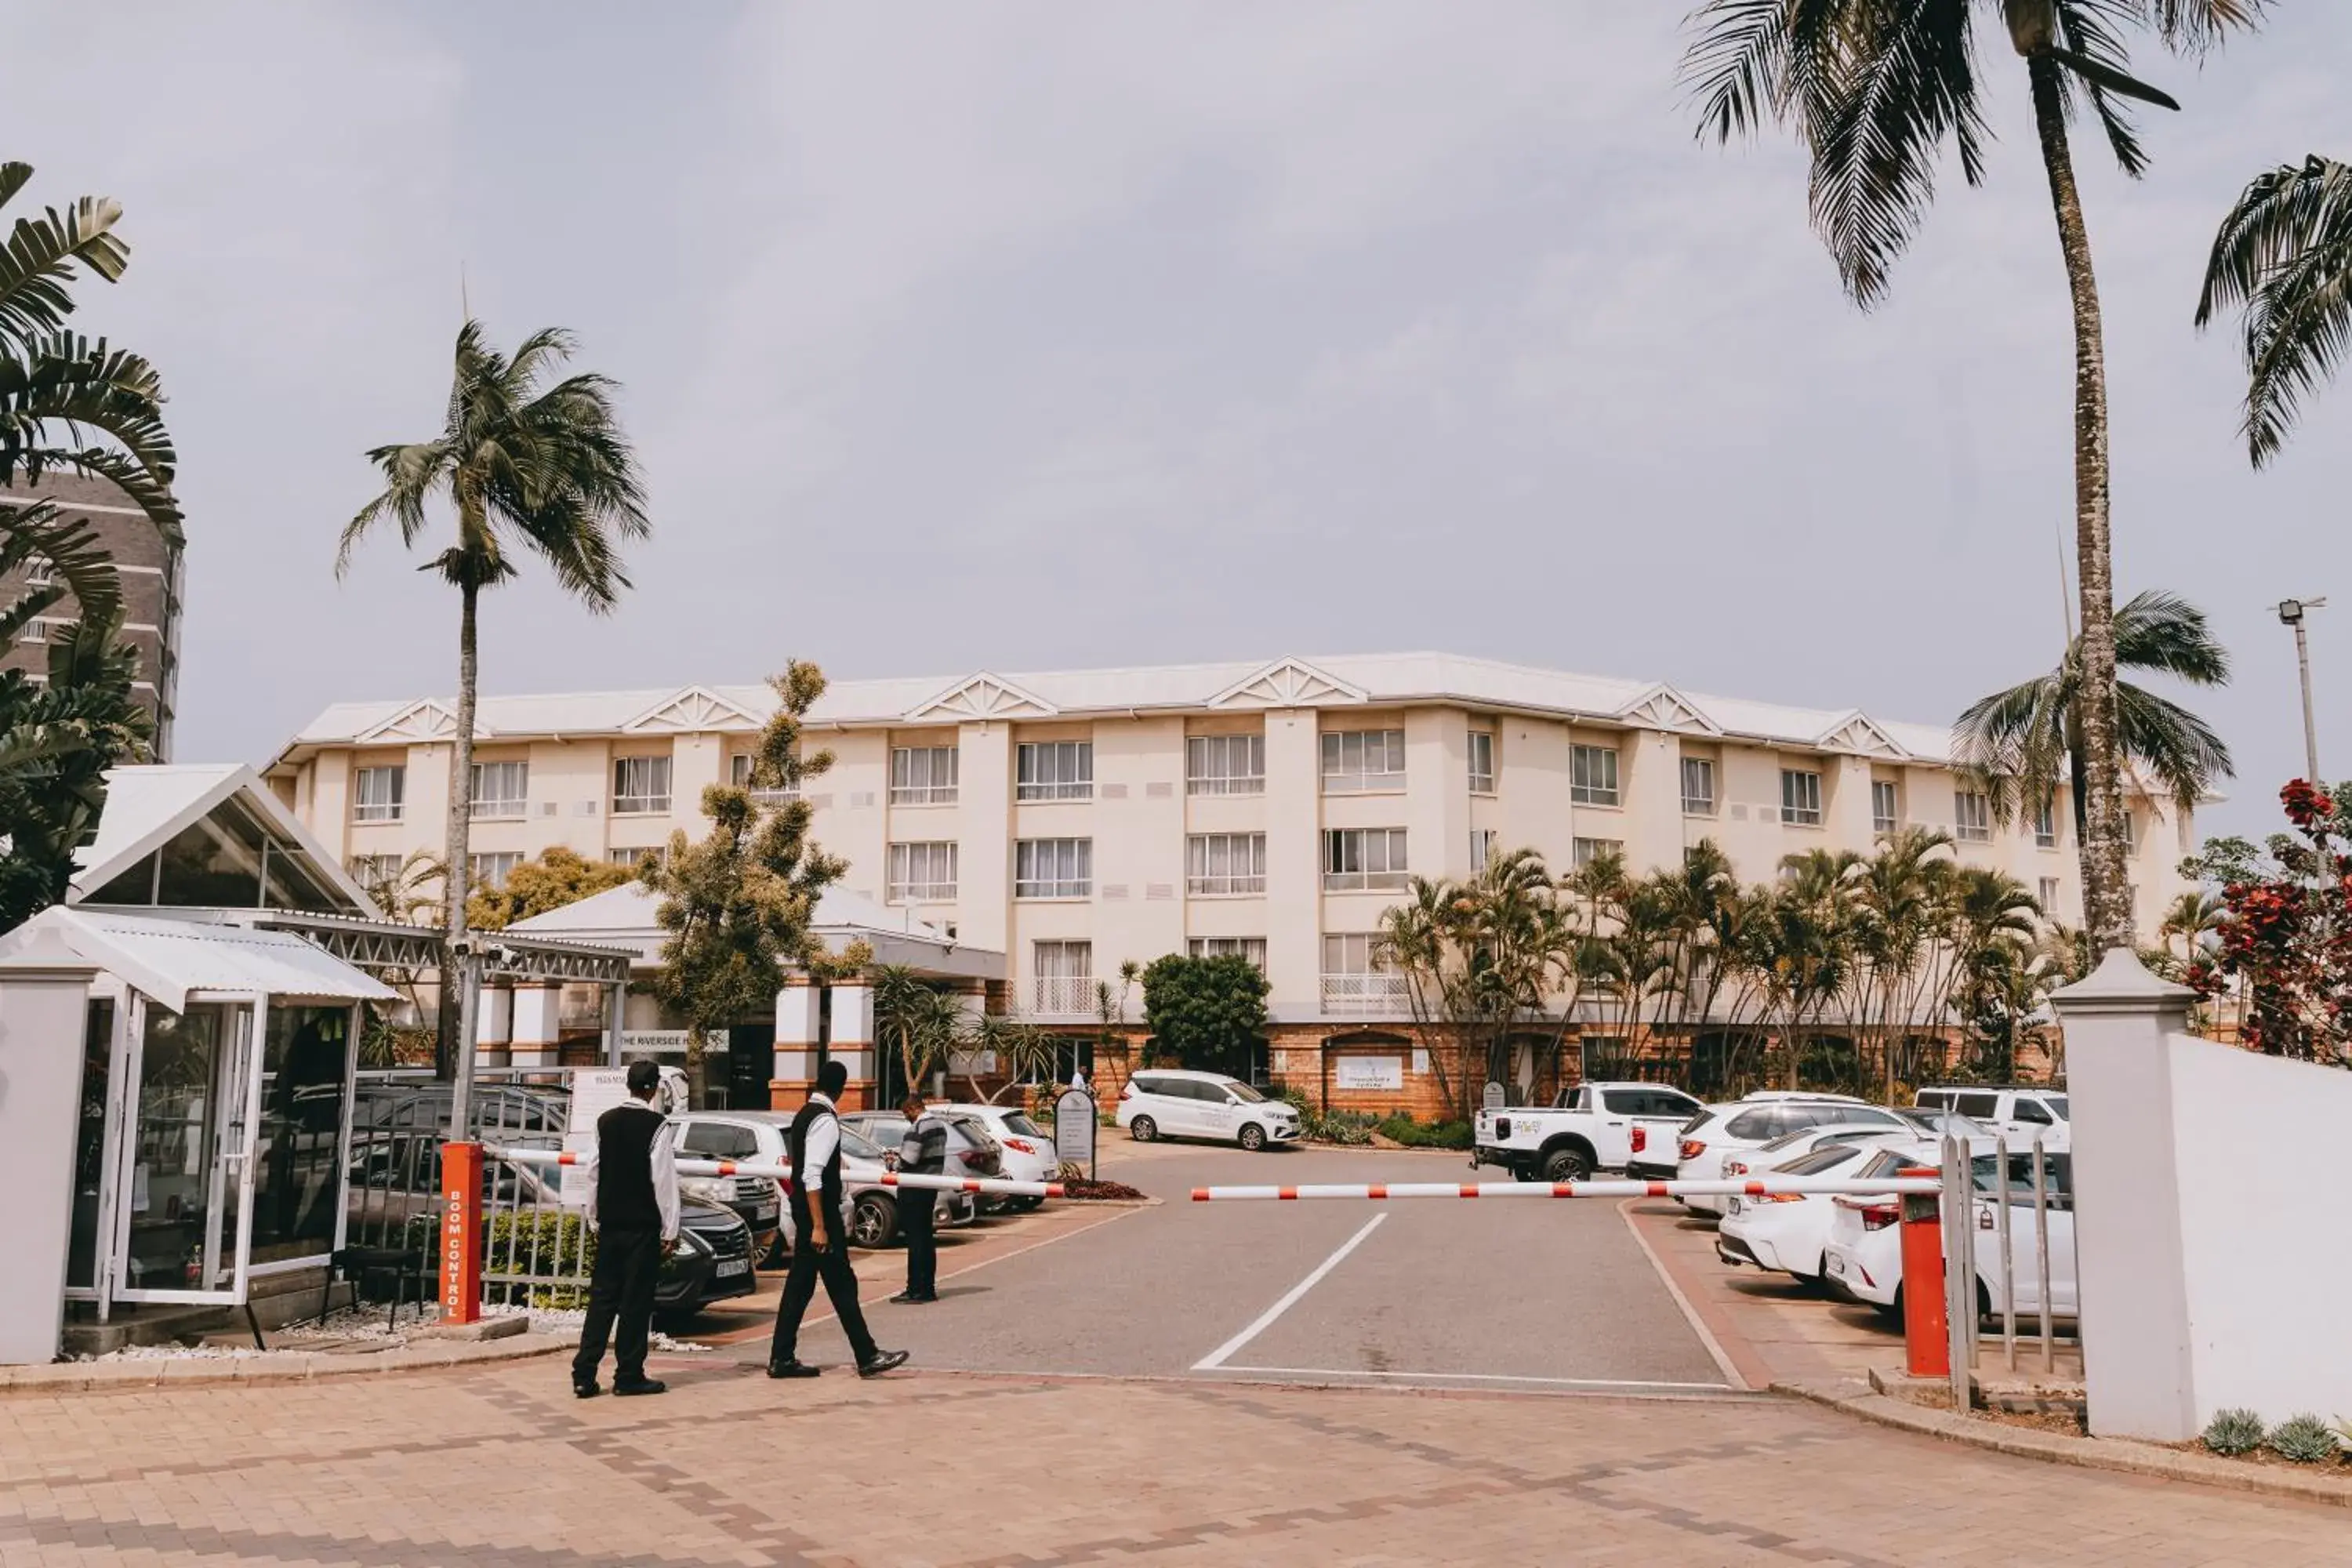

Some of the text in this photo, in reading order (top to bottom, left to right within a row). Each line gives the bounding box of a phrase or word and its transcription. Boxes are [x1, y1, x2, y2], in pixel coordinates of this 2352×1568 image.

[637, 1035, 681, 1046] RIVERSIDE
[447, 1191, 462, 1318] BOOM CONTROL
